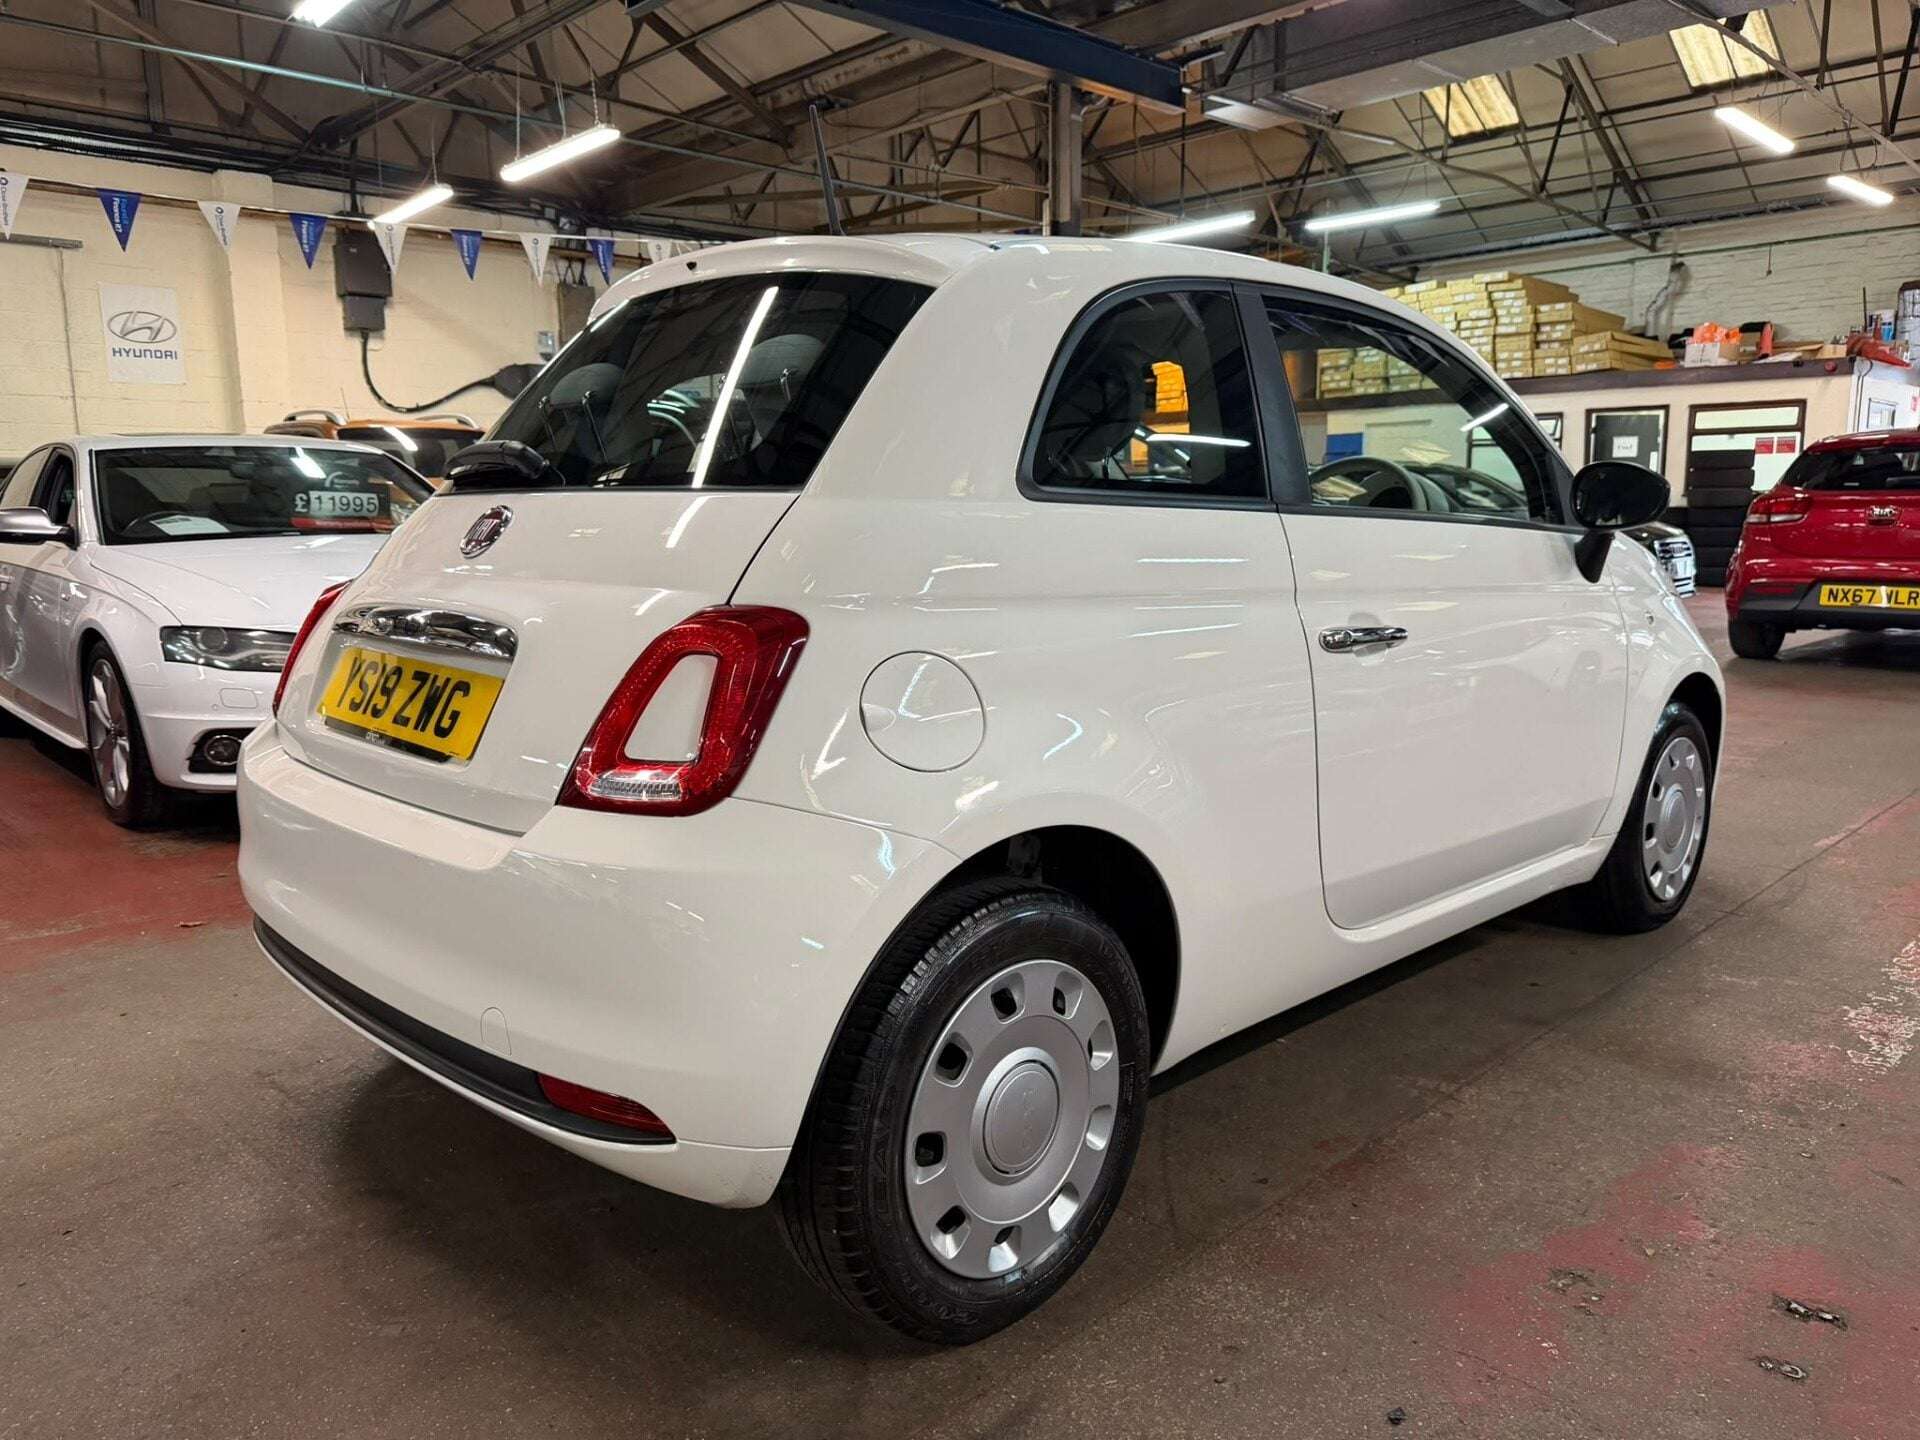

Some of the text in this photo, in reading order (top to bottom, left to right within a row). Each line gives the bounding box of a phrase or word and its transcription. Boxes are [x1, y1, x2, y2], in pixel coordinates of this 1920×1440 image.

[112, 348, 178, 360] HYUNDAI
[295, 493, 377, 513] £11995
[1827, 588, 1876, 604] NX67
[337, 656, 471, 738] YS19 ZWG
